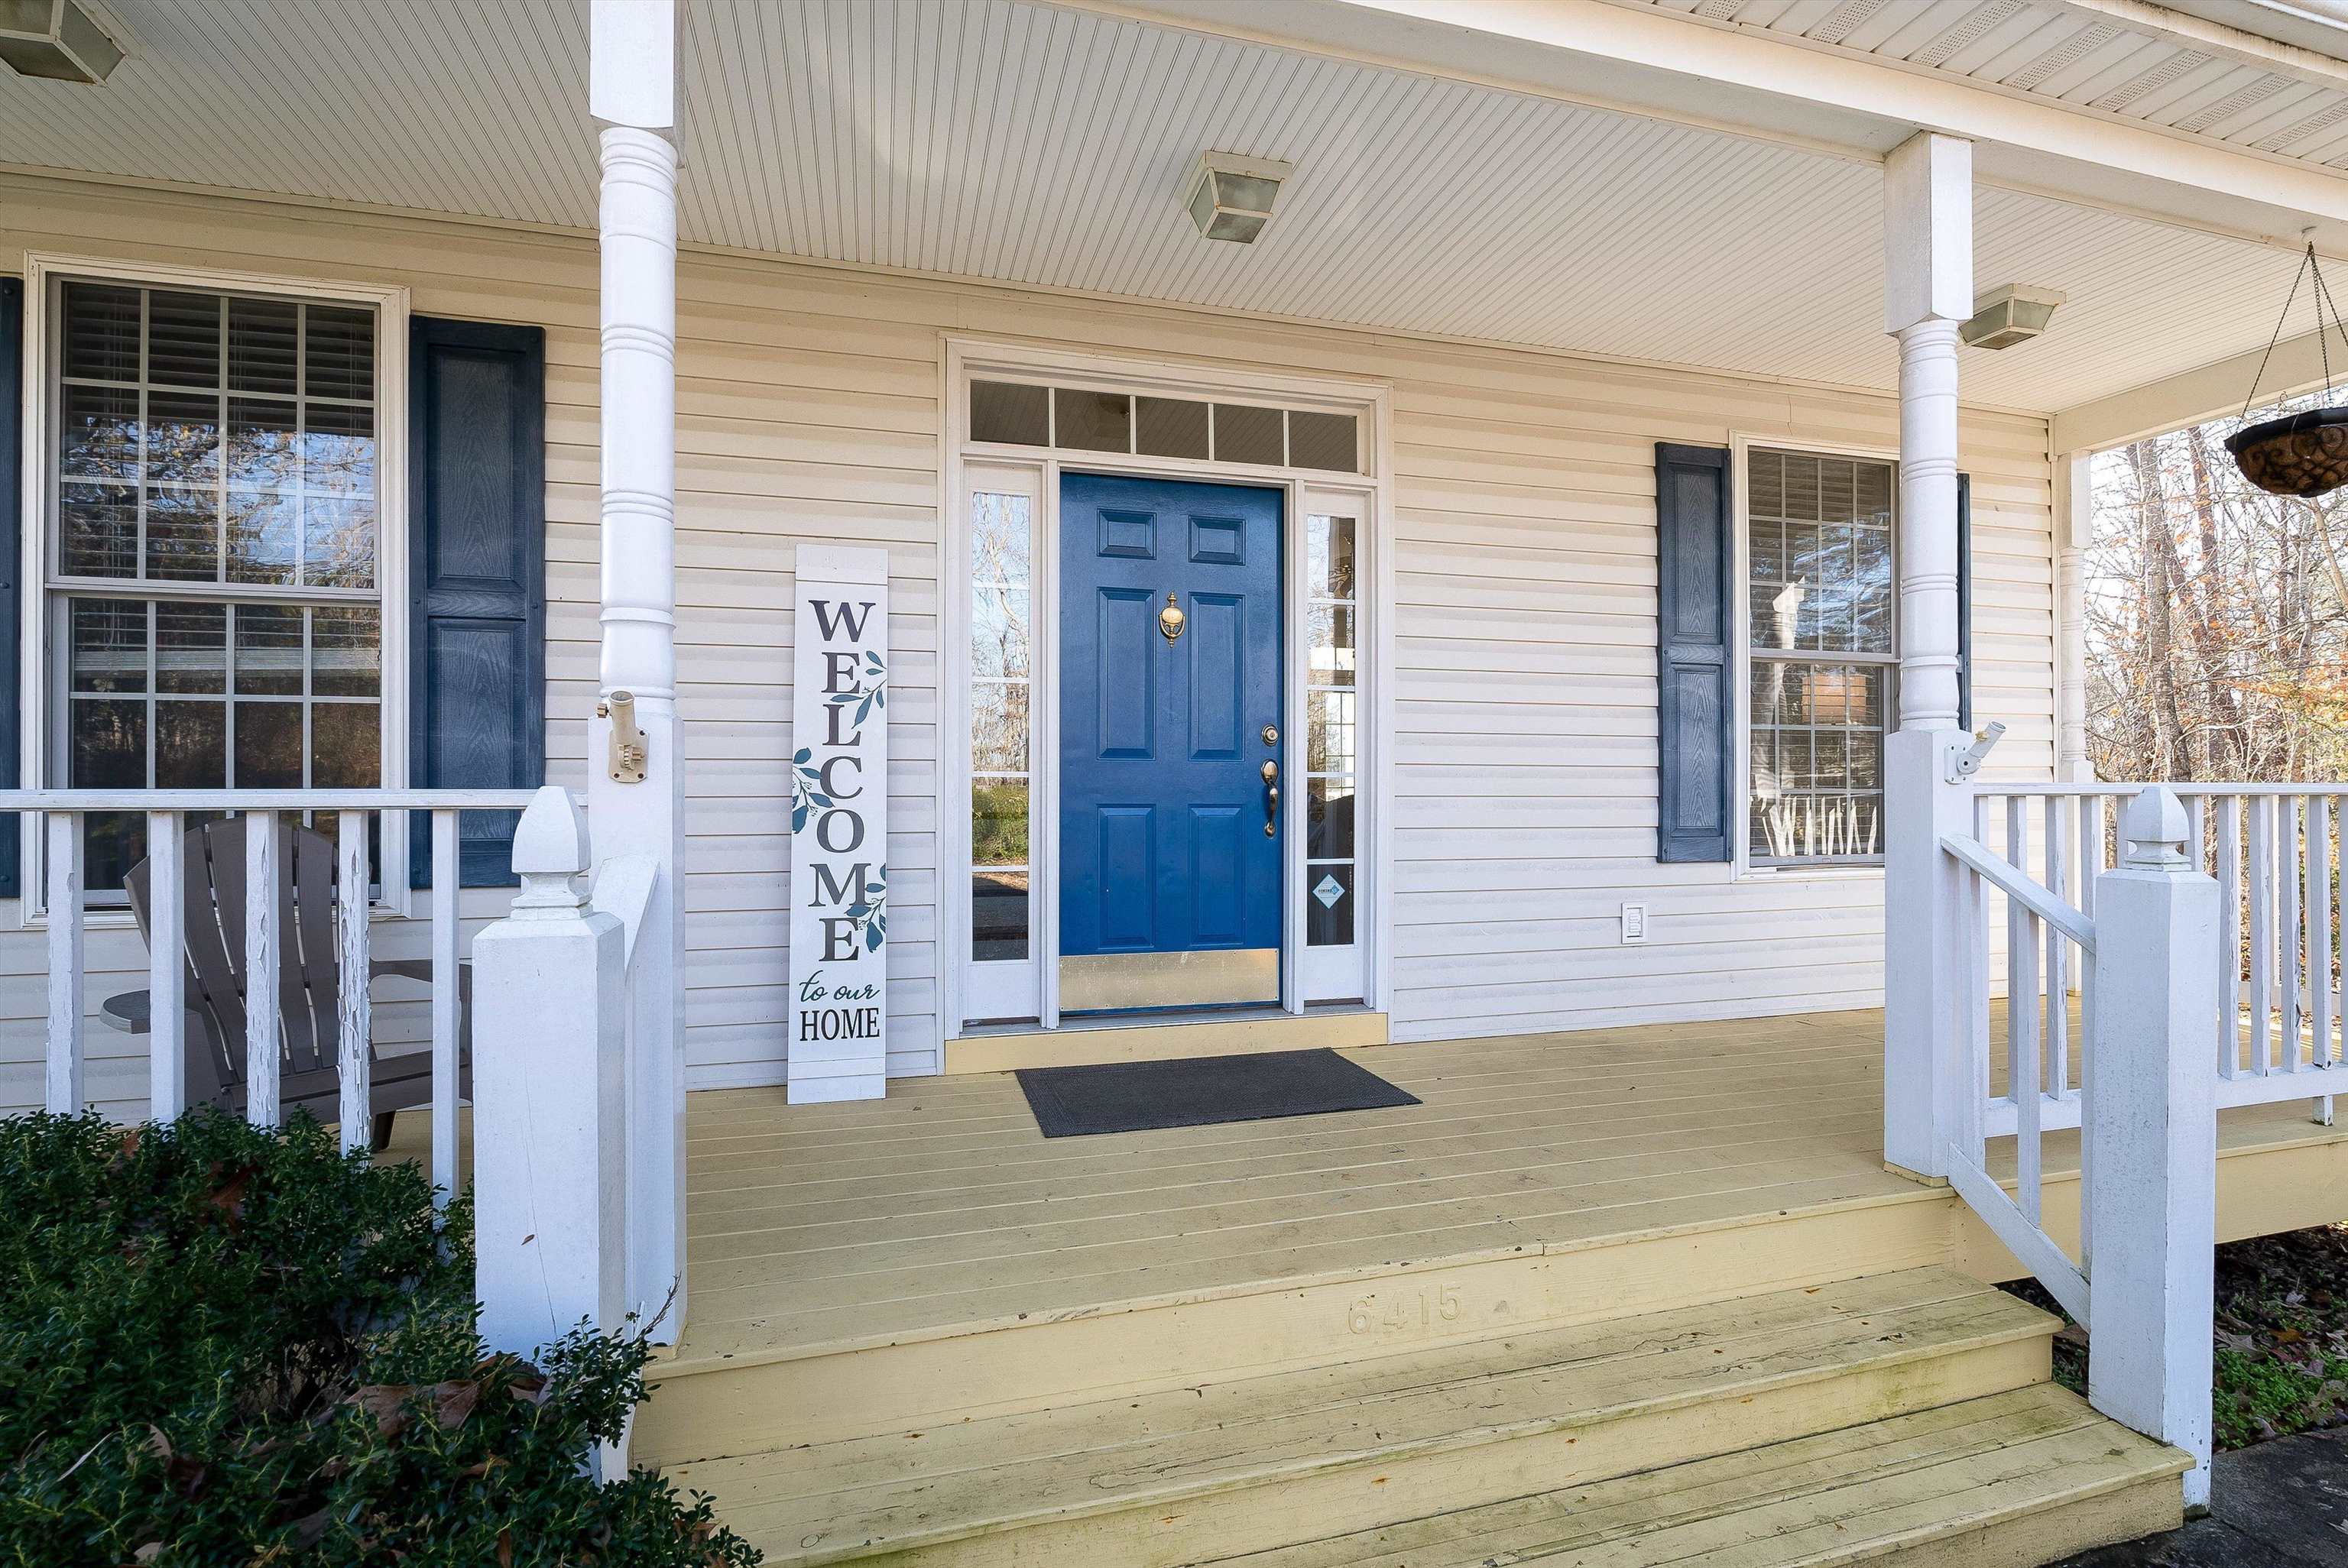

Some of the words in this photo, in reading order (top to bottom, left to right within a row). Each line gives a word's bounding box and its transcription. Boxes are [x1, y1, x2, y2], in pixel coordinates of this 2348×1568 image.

[808, 600, 877, 962] WELCOME
[799, 970, 829, 1003] to
[833, 983, 880, 1000] our
[799, 1007, 880, 1042] HOME
[1348, 1283, 1461, 1334] 6415
